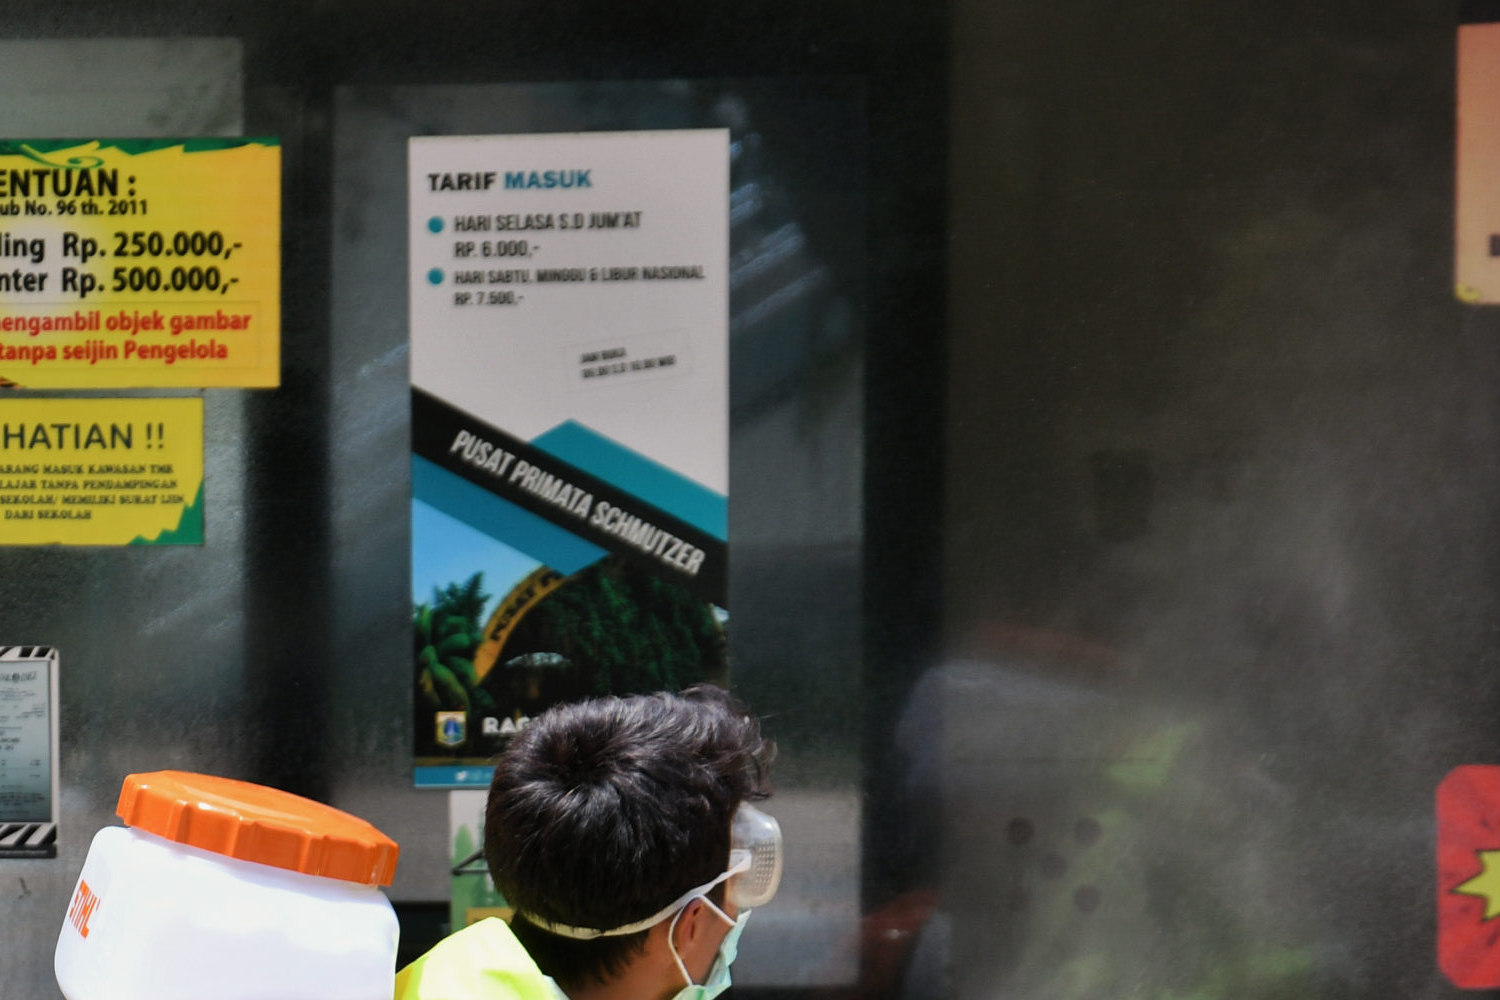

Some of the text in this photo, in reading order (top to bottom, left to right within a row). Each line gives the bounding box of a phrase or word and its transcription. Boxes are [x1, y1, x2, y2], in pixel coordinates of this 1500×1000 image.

[428, 169, 592, 191] TARIF MASUK
[25, 200, 52, 216] No.
[56, 200, 77, 216] 96
[81, 198, 104, 216] th.
[108, 199, 148, 215] 2011
[454, 215, 492, 232] HARI
[496, 213, 554, 231] SELASA
[63, 232, 106, 263] Rp.
[114, 231, 242, 260] 250.000,-
[454, 240, 539, 258] RP. 6.000,-
[62, 267, 105, 298] Rp.
[113, 266, 239, 294] 500.000,-
[454, 270, 485, 284] HARI
[536, 267, 586, 282] MINGGU
[602, 266, 638, 281] LIBUR
[642, 264, 705, 280] NASIONAL
[106, 310, 165, 335] objek
[170, 309, 252, 335] gambar
[62, 340, 118, 365] seijin
[124, 339, 228, 364] Pengelola
[146, 422, 165, 449] !!
[43, 464, 84, 474] MASUK
[88, 464, 146, 474] KAWASAN
[41, 480, 78, 489] TANPA
[83, 480, 177, 489] PENDAMPINGAN
[120, 494, 157, 504] SURAT
[450, 429, 706, 576] PUSAT PRIMATA SCHMUTZER
[4, 510, 91, 520] DARI SEKOLAH
